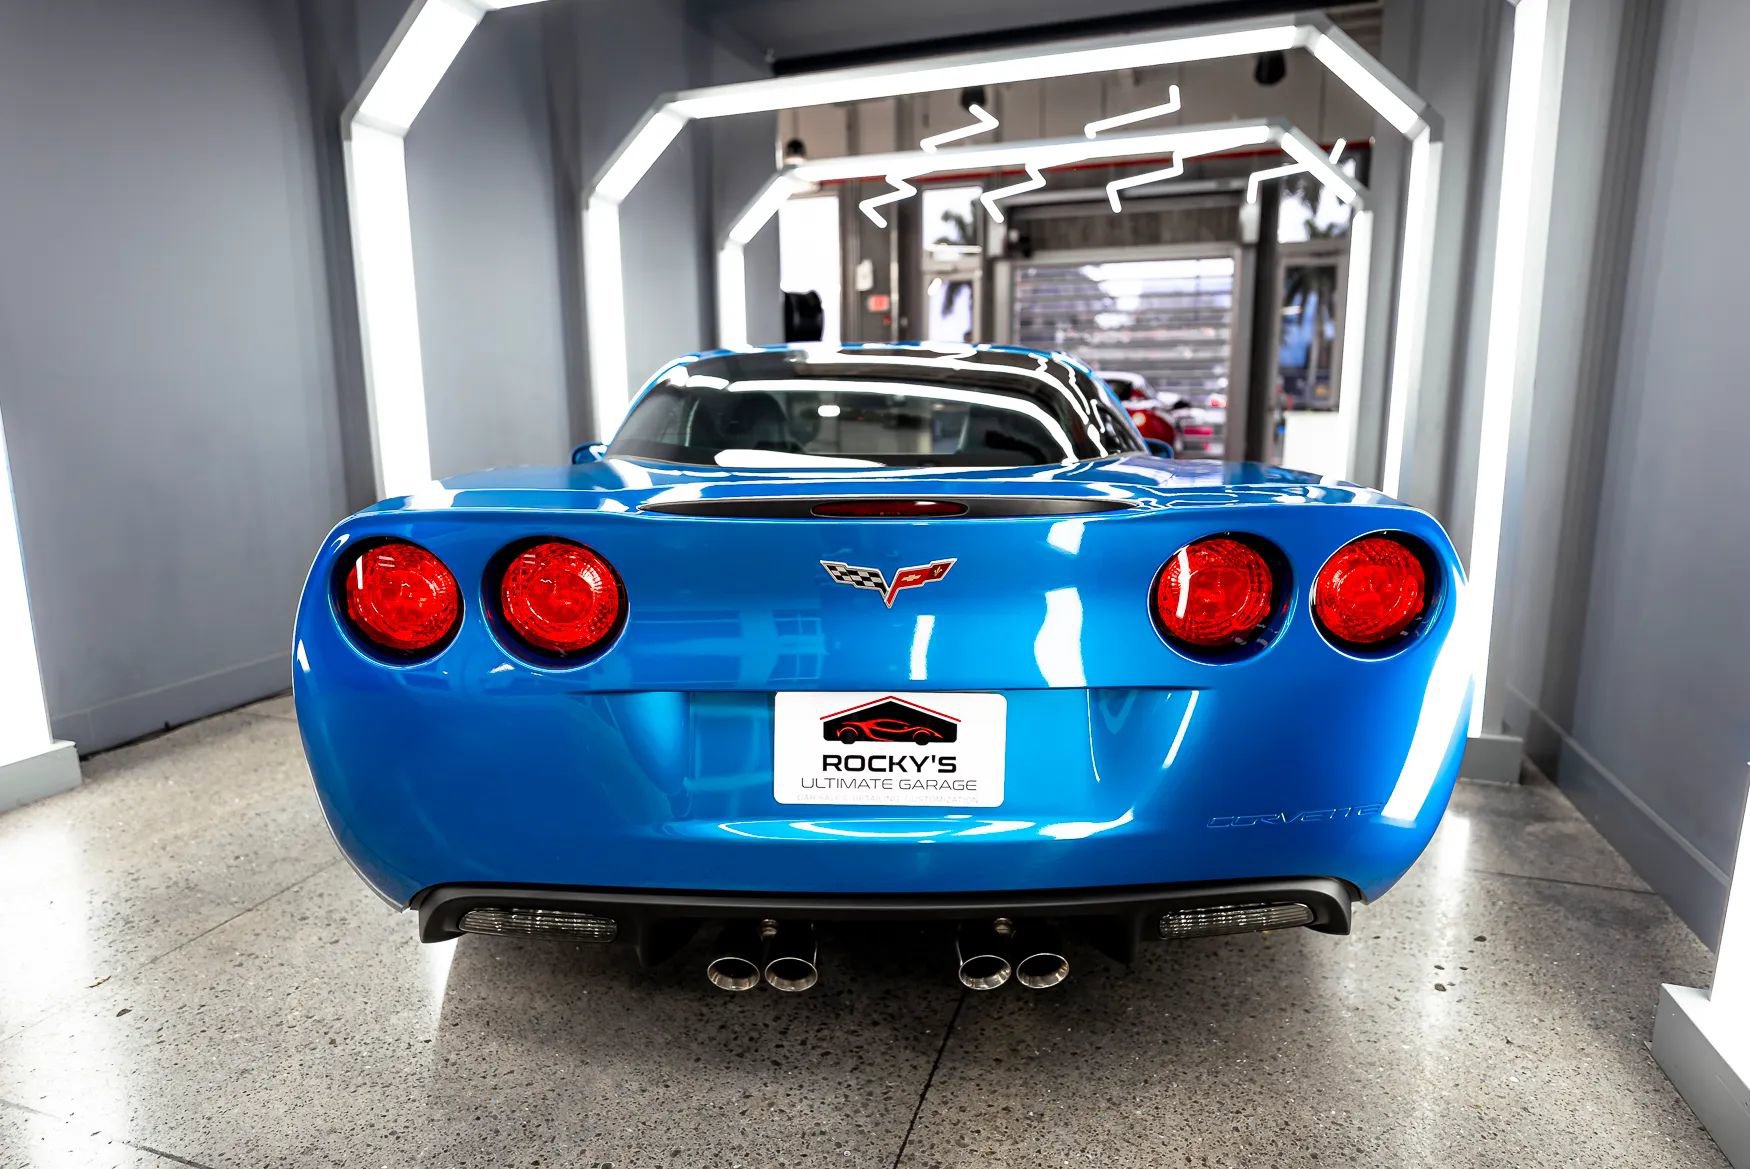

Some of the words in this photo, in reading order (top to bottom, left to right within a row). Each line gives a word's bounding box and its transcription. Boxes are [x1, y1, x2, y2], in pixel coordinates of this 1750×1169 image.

[822, 754, 957, 774] ROCKY'S
[801, 777, 893, 790] ULTIMATE
[898, 779, 977, 791] GARAGE
[1206, 802, 1384, 828] CORVETTE
